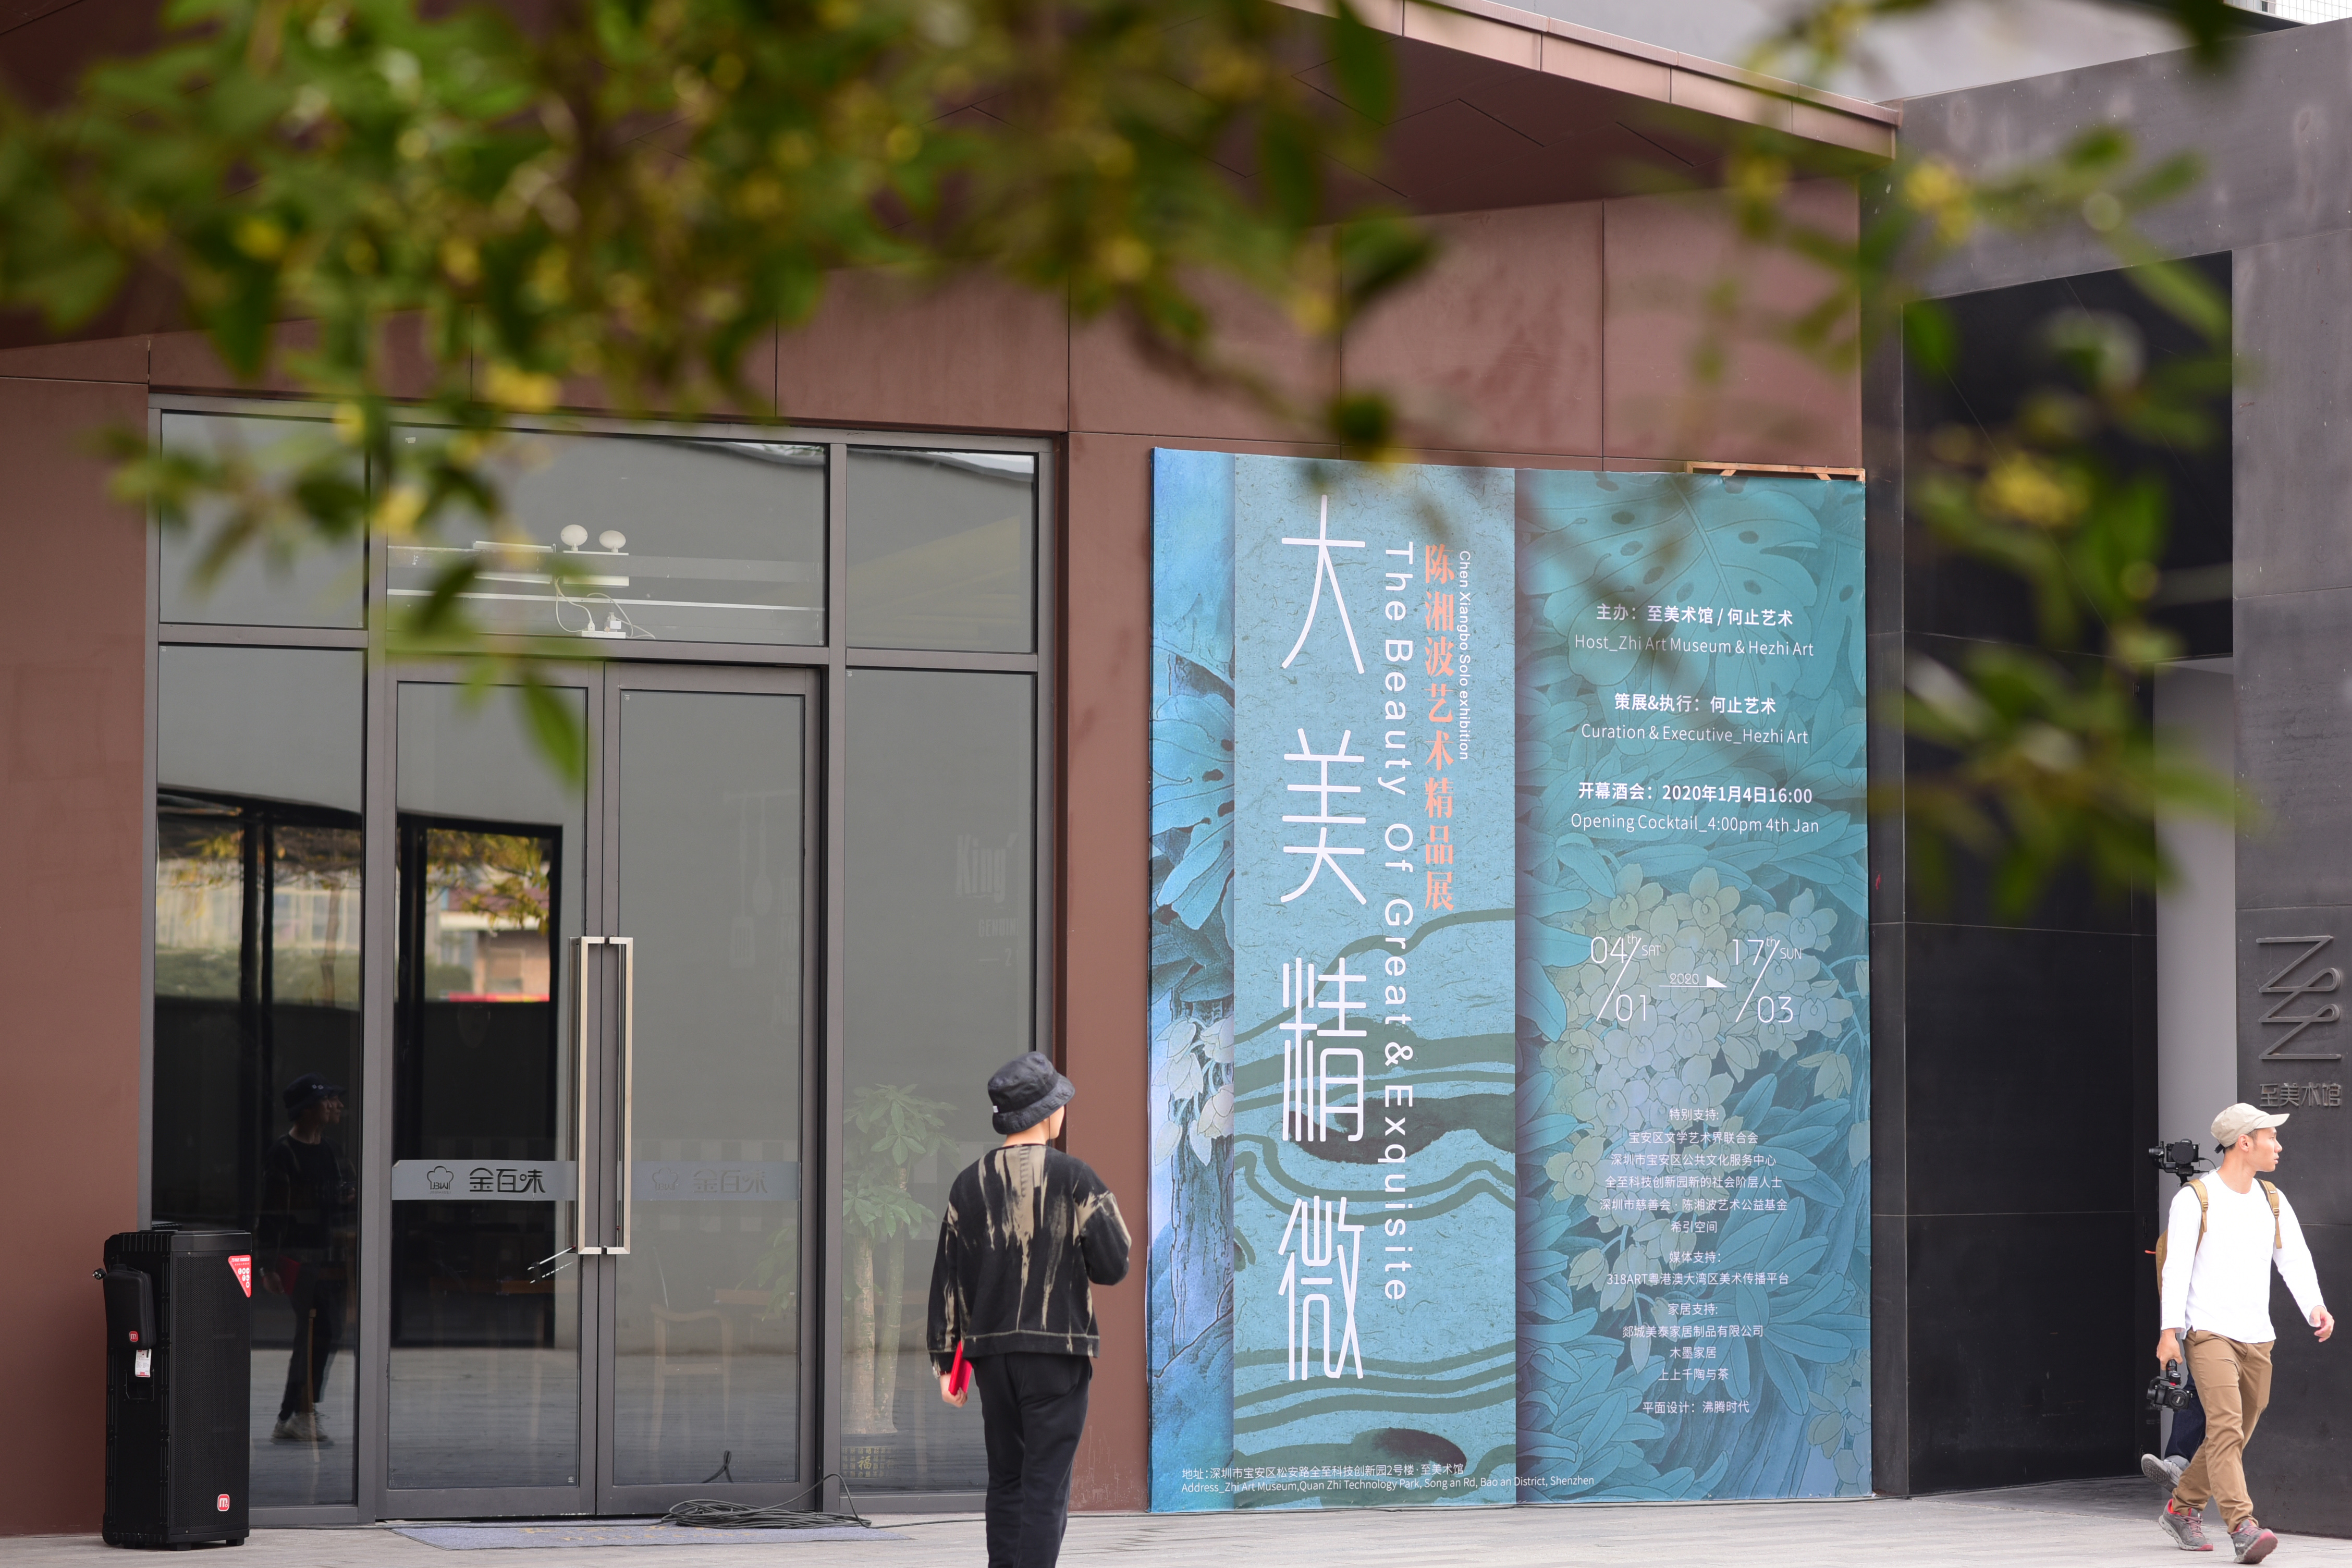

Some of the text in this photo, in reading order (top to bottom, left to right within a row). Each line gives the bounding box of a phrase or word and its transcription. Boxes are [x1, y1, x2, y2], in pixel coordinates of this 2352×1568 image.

[1728, 608, 1793, 627] 何止艺术
[1457, 551, 1471, 759] Chen Xiangbo Solo exhibition
[1646, 637, 1666, 651] Art
[1671, 638, 1731, 653] Museum
[1735, 640, 1745, 653] &
[1749, 641, 1788, 655] Hezhi
[1793, 642, 1814, 656] Art
[1425, 544, 1454, 911] 陈湘波艺术精品展
[1582, 724, 1645, 739] Curation
[1649, 726, 1659, 739] &
[1787, 730, 1808, 743] Art
[1572, 813, 1634, 832] Opening
[1766, 817, 1788, 831] 4th
[1794, 819, 1818, 832] Jan
[978, 918, 1018, 937] GENUIN
[1378, 542, 1413, 1300] The Beauty Of Great & Exquisite
[1278, 495, 1367, 1380] 大美精微
[1642, 945, 1661, 956] SAT
[1780, 948, 1801, 959] SUN
[1670, 973, 1698, 984] 2020
[1616, 995, 1645, 1021] 01
[1758, 996, 1793, 1023] 03
[2259, 1082, 2342, 1107] 至美术馆
[1629, 1131, 1758, 1144] 宝安区文学艺术界联合会
[1611, 1153, 1776, 1166] 深圳市宝安区公共文化服务中心
[469, 1167, 546, 1193] 金百味
[1606, 1175, 1782, 1188] 全至科技创新园新的社会阶层人士
[1671, 1221, 1717, 1233] 希引空间
[1670, 1346, 1716, 1358] 木墨家居
[1659, 1368, 1729, 1380] 上上千陶与茶
[1242, 1483, 1255, 1491] Art
[1327, 1480, 1341, 1489] Zhi
[1344, 1479, 1397, 1491] Technology
[1400, 1478, 1422, 1489] Park,
[1425, 1478, 1448, 1490] Song
[1464, 1477, 1477, 1488] Rd,
[1481, 1478, 1498, 1486] Bao
[1514, 1477, 1547, 1487] District,
[1551, 1476, 1594, 1485] Shenzhen
